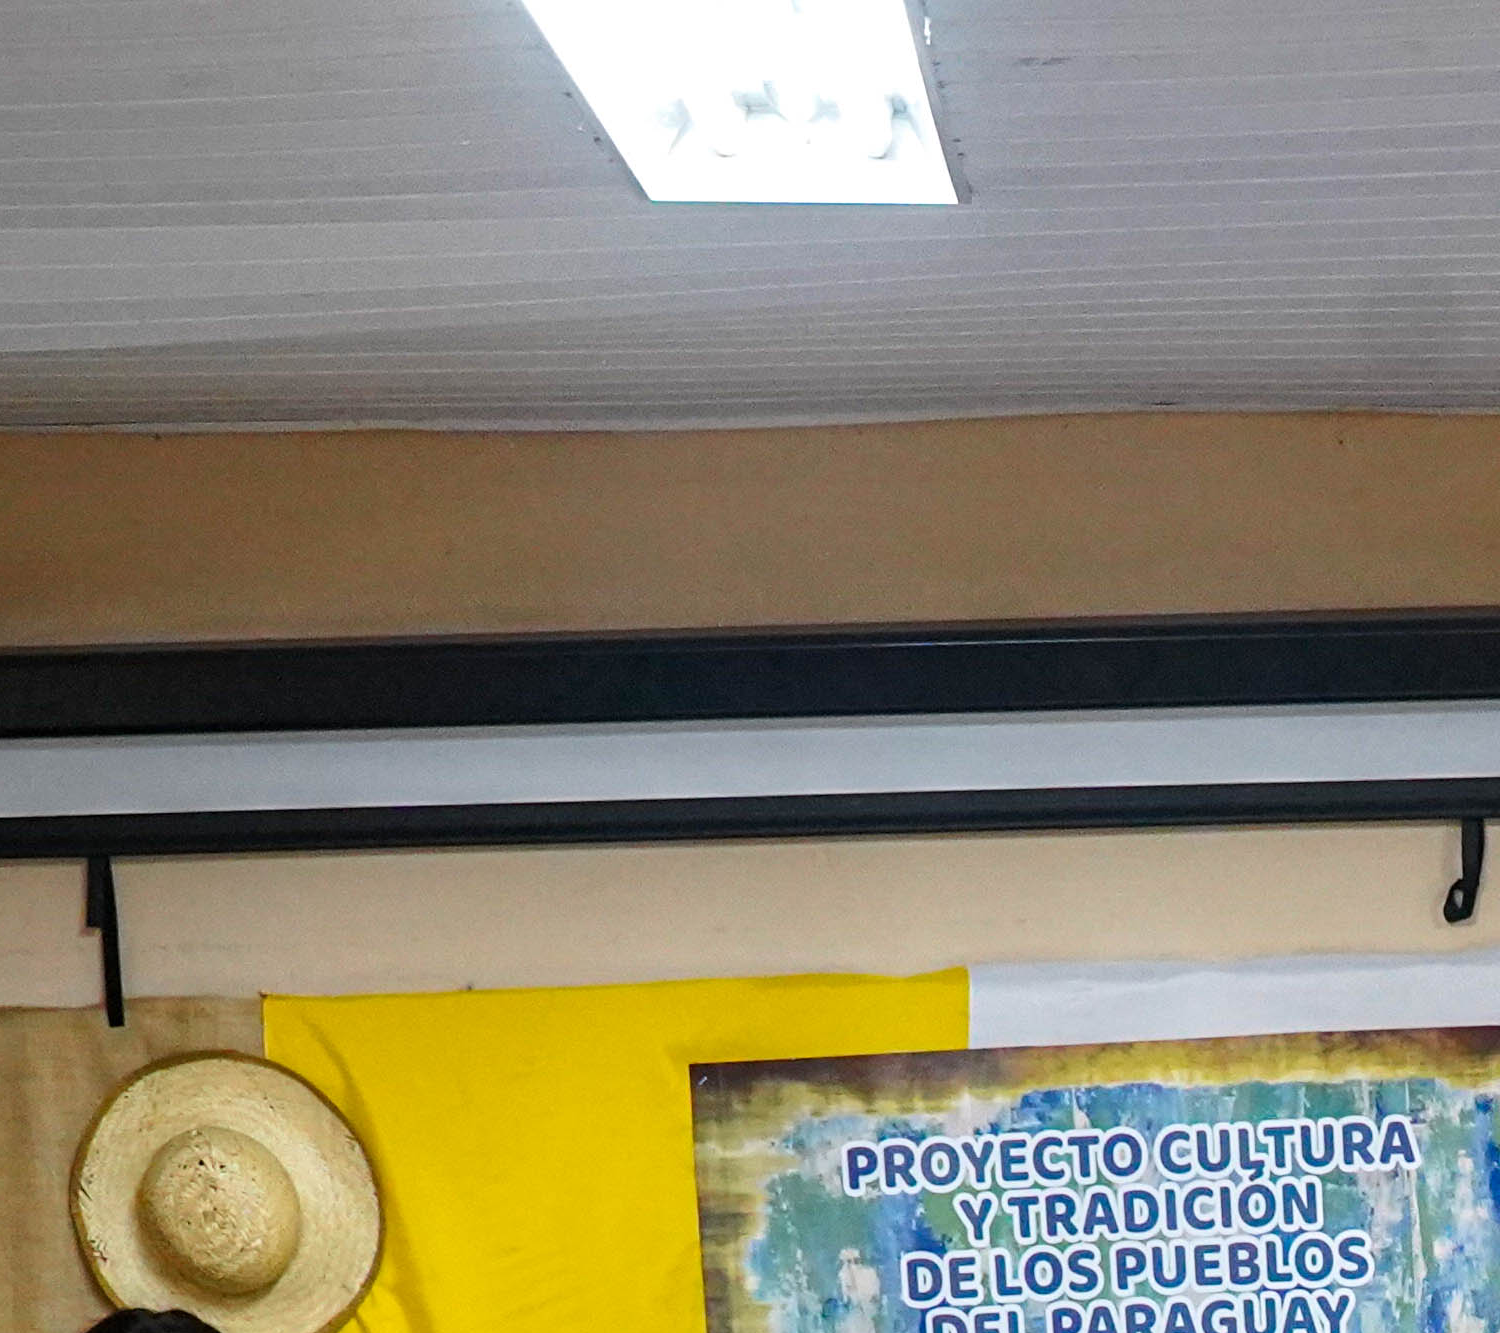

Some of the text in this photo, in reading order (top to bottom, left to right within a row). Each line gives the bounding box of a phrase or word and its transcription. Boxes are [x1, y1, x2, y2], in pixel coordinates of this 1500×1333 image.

[847, 1120, 1416, 1190] PROYECTO CULTURA
[960, 1172, 1319, 1240] Y TRADICIÓN
[907, 1236, 1369, 1302] DE LOS PUEBLOS
